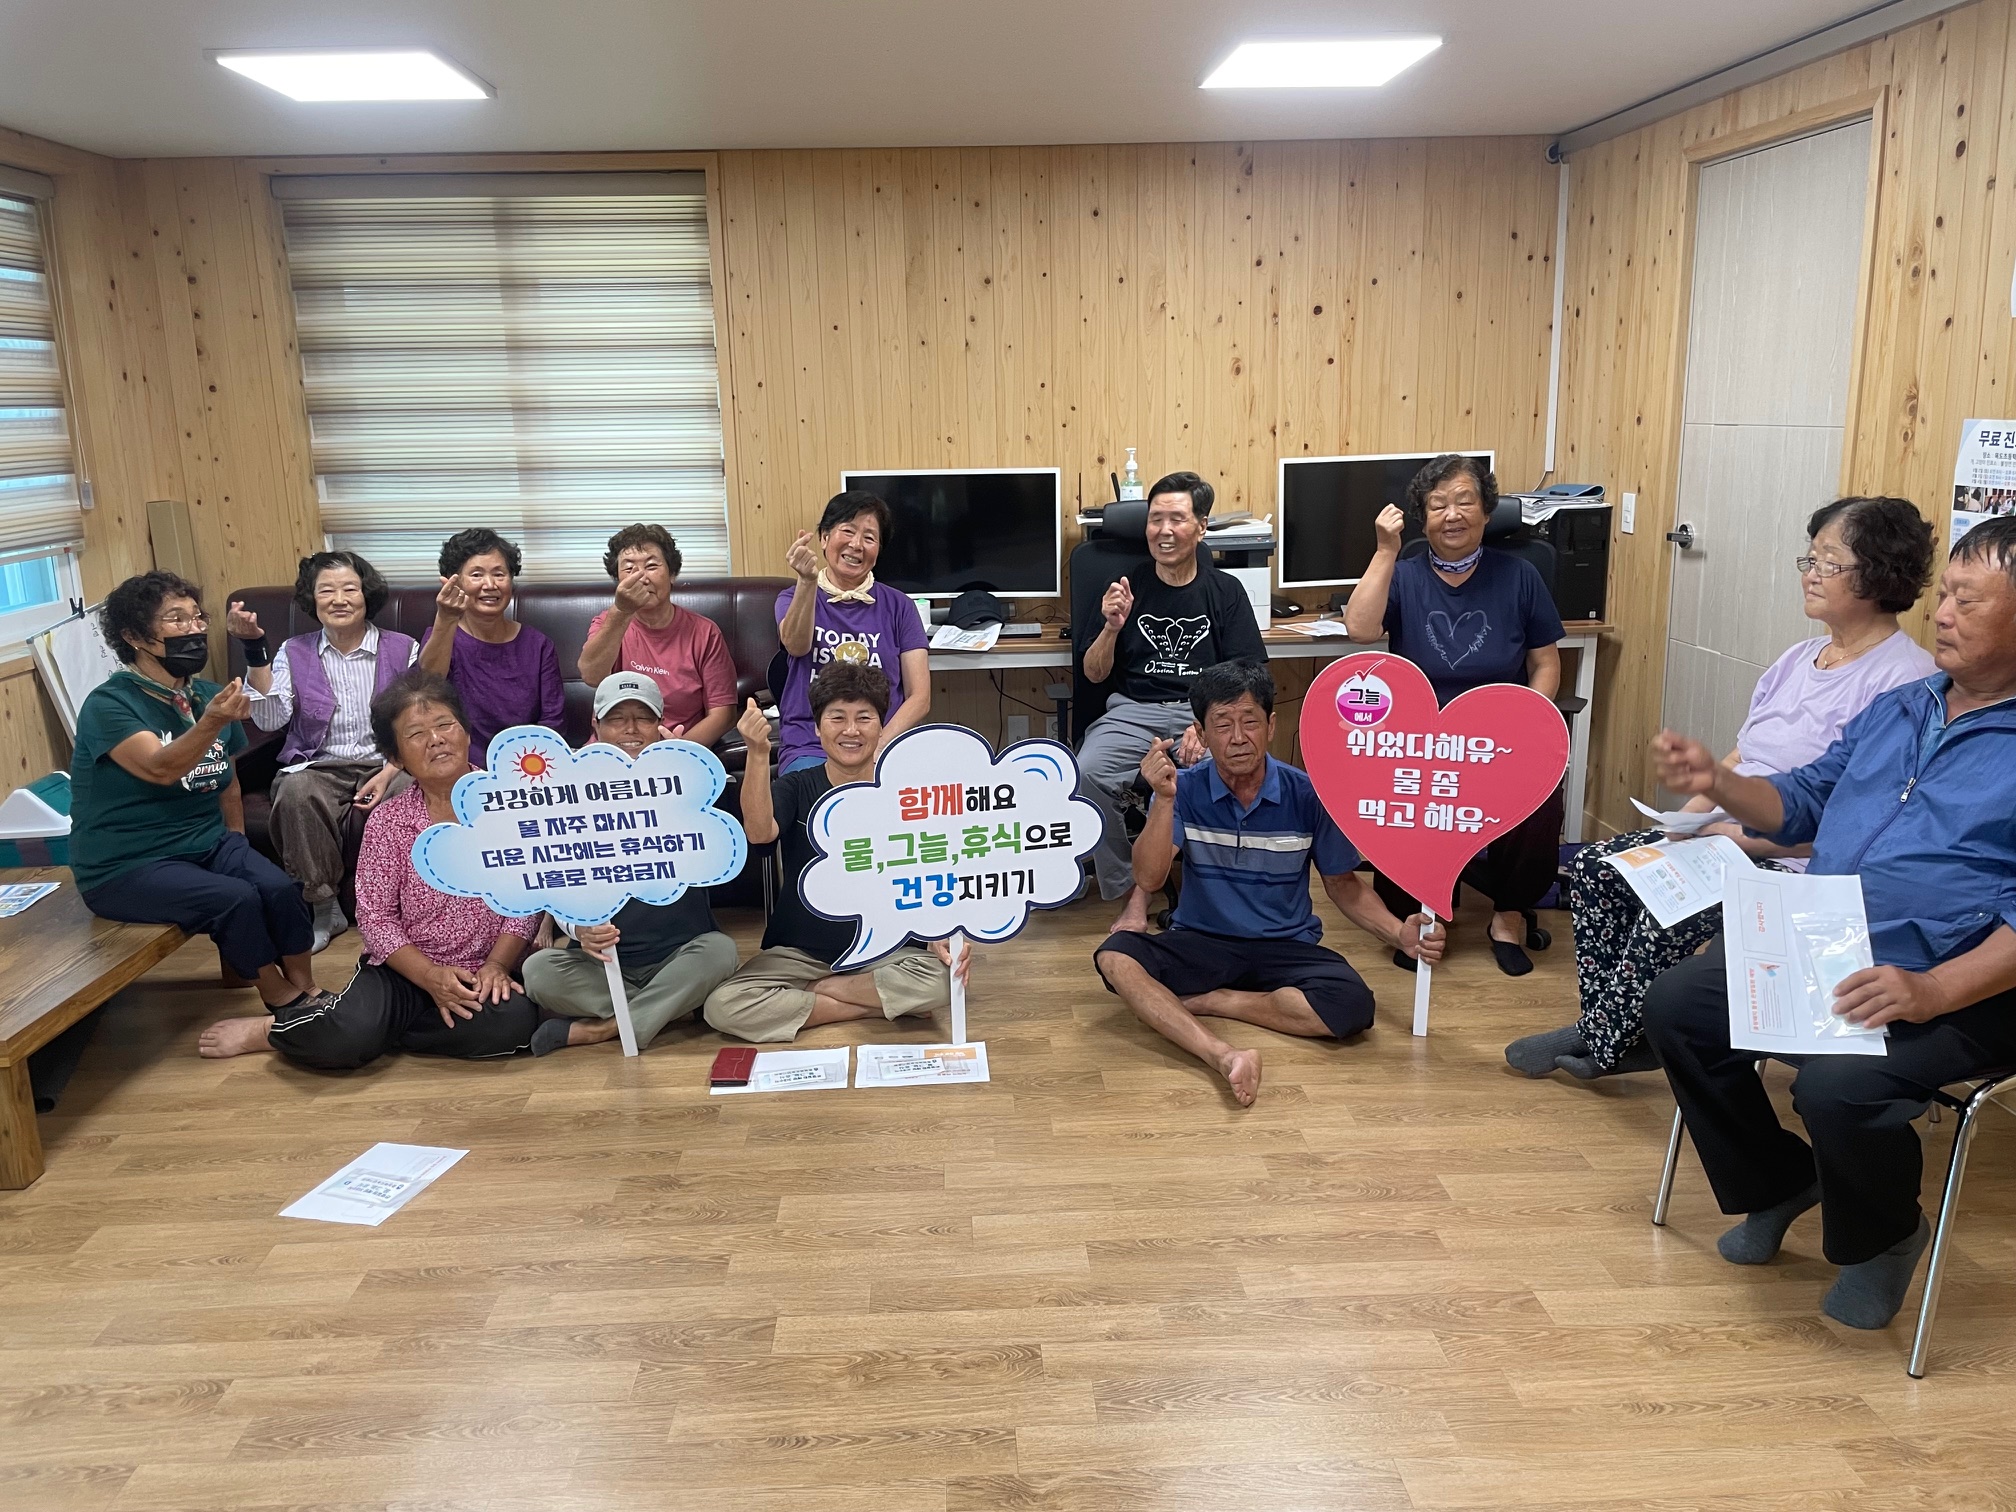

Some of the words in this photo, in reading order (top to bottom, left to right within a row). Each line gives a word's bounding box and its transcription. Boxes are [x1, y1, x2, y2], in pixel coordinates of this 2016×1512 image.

[1978, 430, 2002, 448] 무료
[2003, 431, 2016, 449] 진
[815, 626, 881, 648] TODAY
[630, 660, 653, 674] Calvin
[653, 666, 670, 676] Klein
[812, 647, 831, 664] IS
[1347, 687, 1382, 706] 그늘
[1353, 711, 1373, 723] 에서
[1346, 728, 1513, 764] 쉬었다해유~
[478, 784, 580, 812] 건강하게
[585, 775, 683, 804] 여름나기
[1393, 767, 1422, 796] 물
[1431, 769, 1460, 798] 좀
[897, 783, 1017, 821] 함께해요
[1358, 799, 1415, 828] 먹고
[1424, 801, 1501, 834] 해유~
[518, 816, 542, 839] 물
[544, 815, 588, 836] 자주
[594, 809, 659, 832] 마시기
[481, 848, 526, 869] 더운
[532, 838, 616, 864] 시간에는
[620, 832, 705, 856] 휴식하기
[842, 821, 1073, 874] 물,그늘,휴식으로
[522, 868, 587, 891] 나홀로
[591, 860, 677, 884] 작업금지
[892, 868, 1035, 911] 건강지키기
